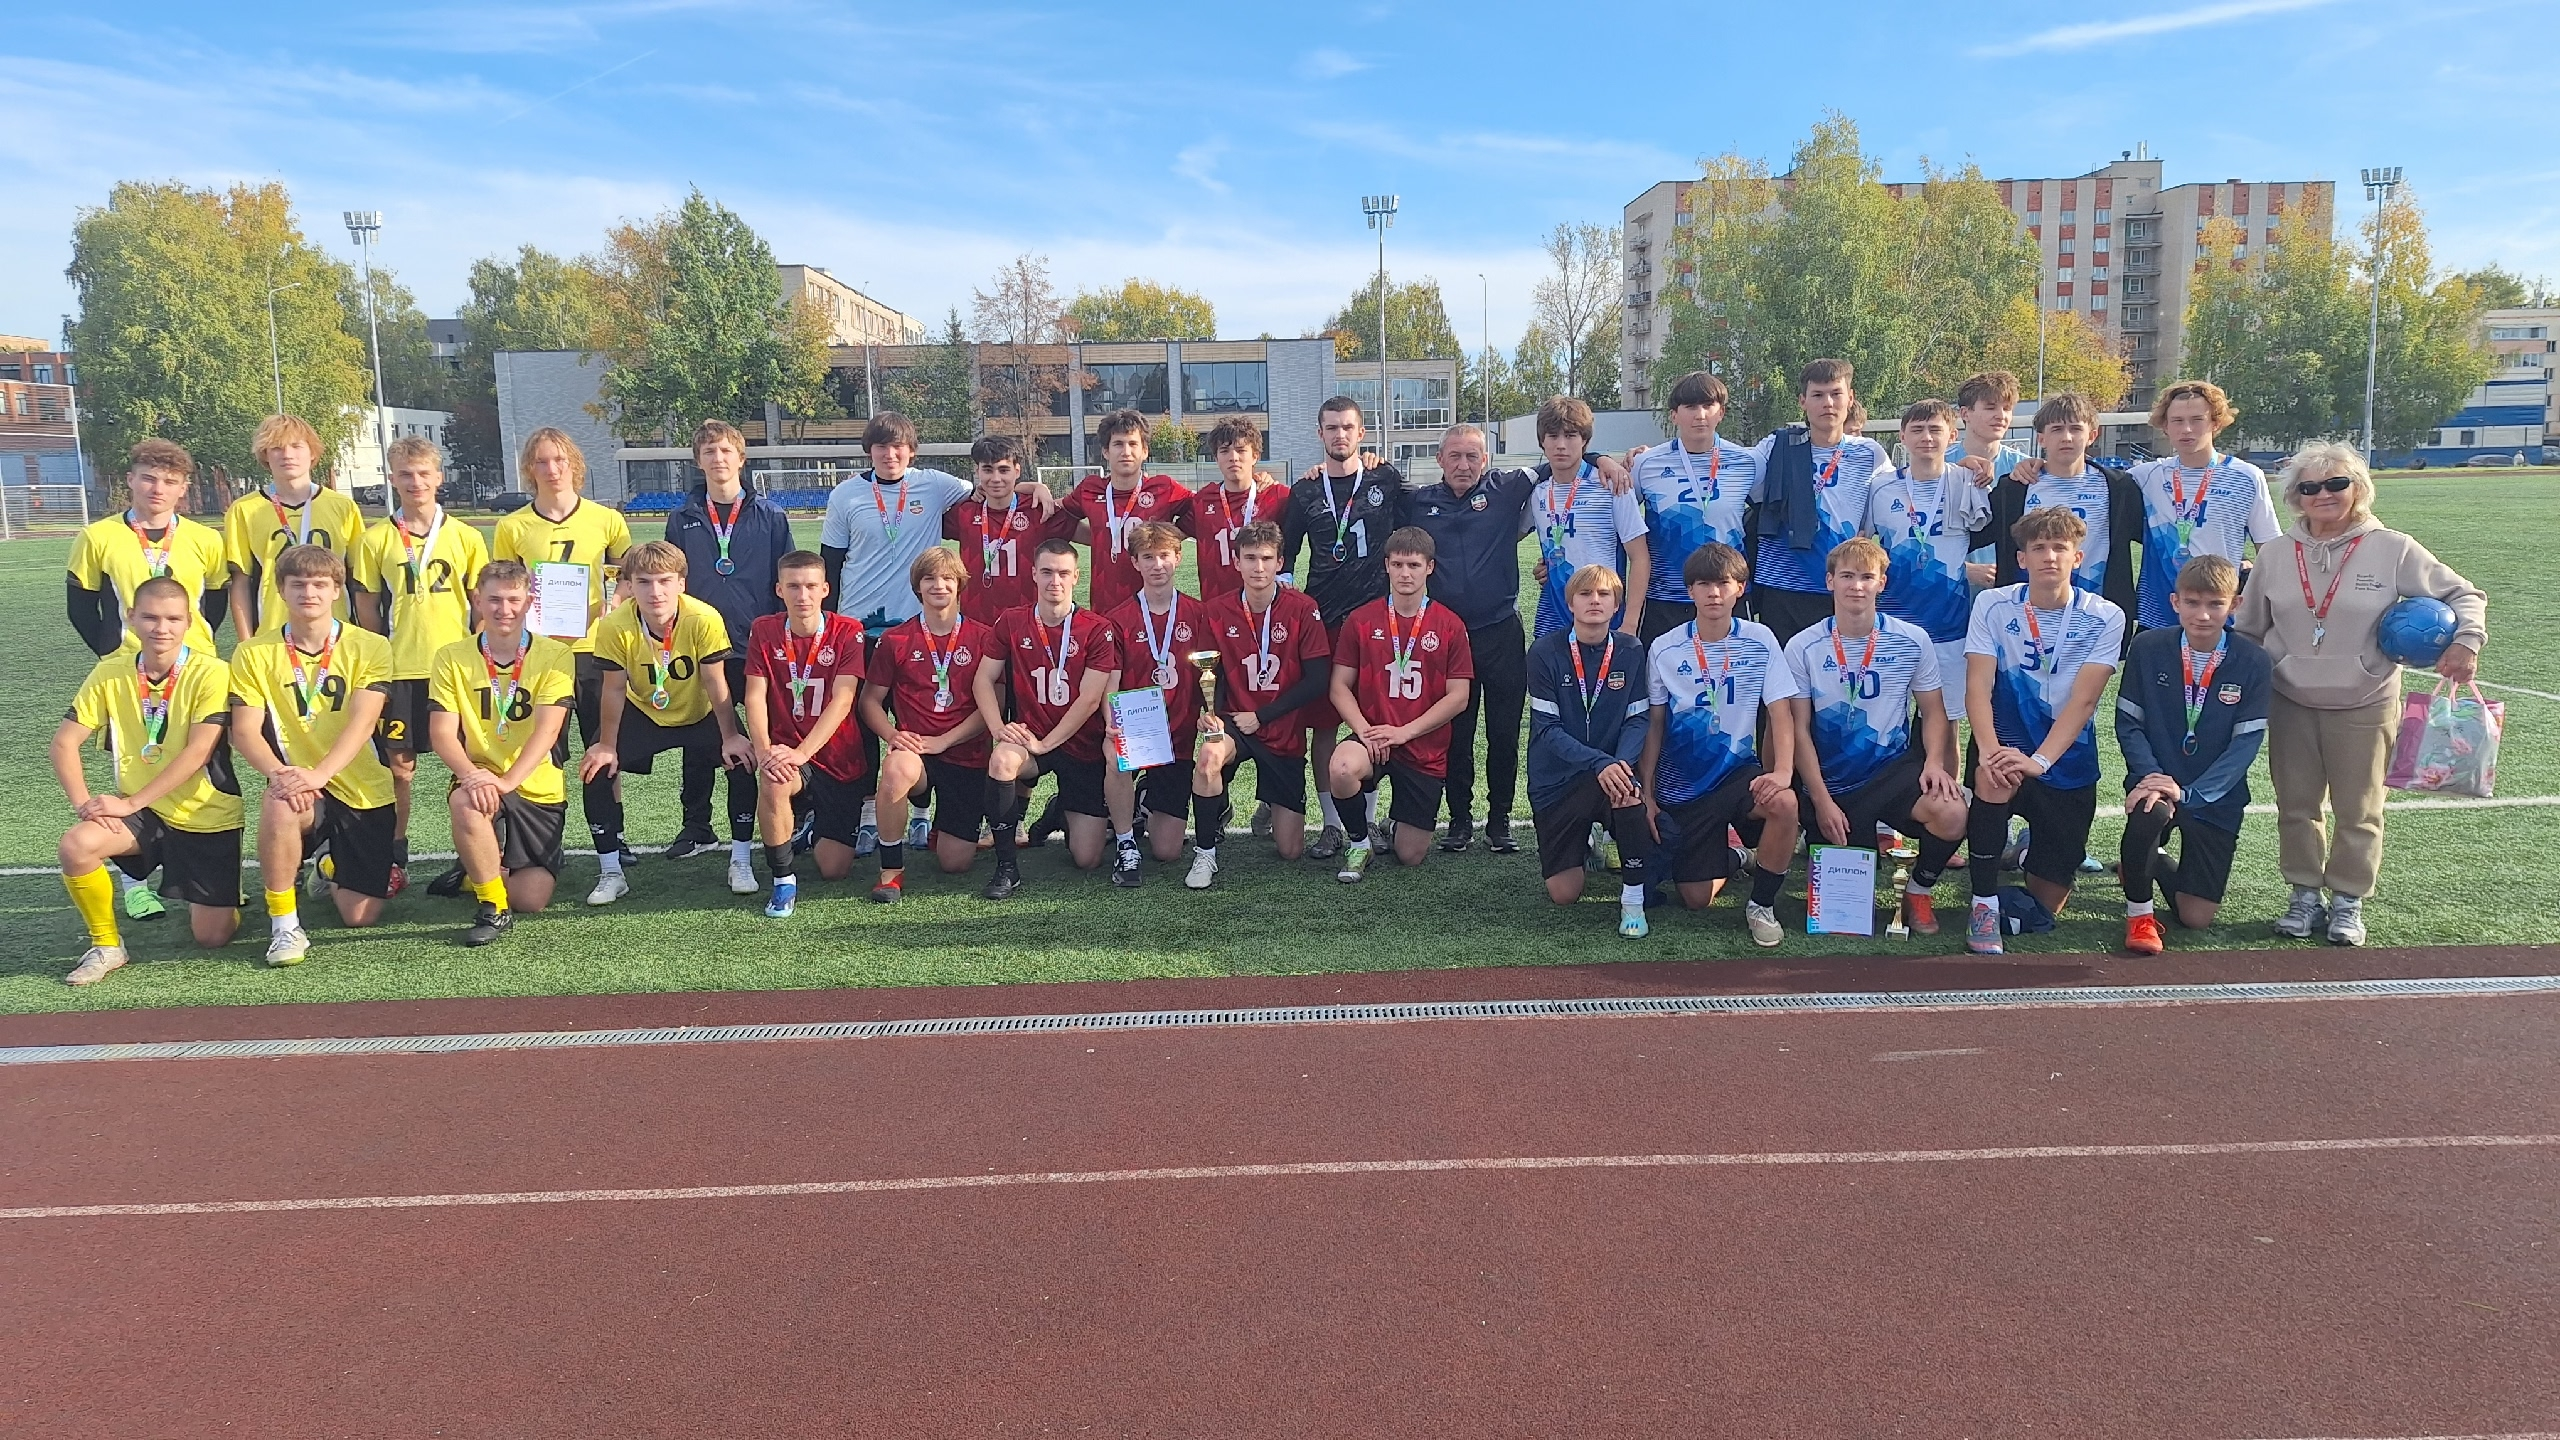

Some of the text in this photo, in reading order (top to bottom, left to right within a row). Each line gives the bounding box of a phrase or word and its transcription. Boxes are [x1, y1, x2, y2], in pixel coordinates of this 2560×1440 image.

[1677, 476, 1720, 503] 23
[1349, 518, 1368, 558] 1
[988, 538, 1017, 577] 11
[397, 558, 452, 595] 12
[547, 579, 582, 587] ДИПЛОМ
[640, 655, 695, 685] 10
[1030, 666, 1070, 707] 16
[1241, 653, 1281, 692] 12
[1384, 659, 1423, 700] 15
[1839, 671, 1881, 700] 10
[283, 674, 347, 717] 19
[473, 686, 533, 722] 18
[785, 677, 825, 718] 17
[1694, 676, 1735, 707] 21
[1127, 705, 1159, 717] ДИПЛОМ
[1811, 847, 1823, 932] НИЖНЕКАМСК
[1827, 866, 1867, 876] ДИПЛОМ
